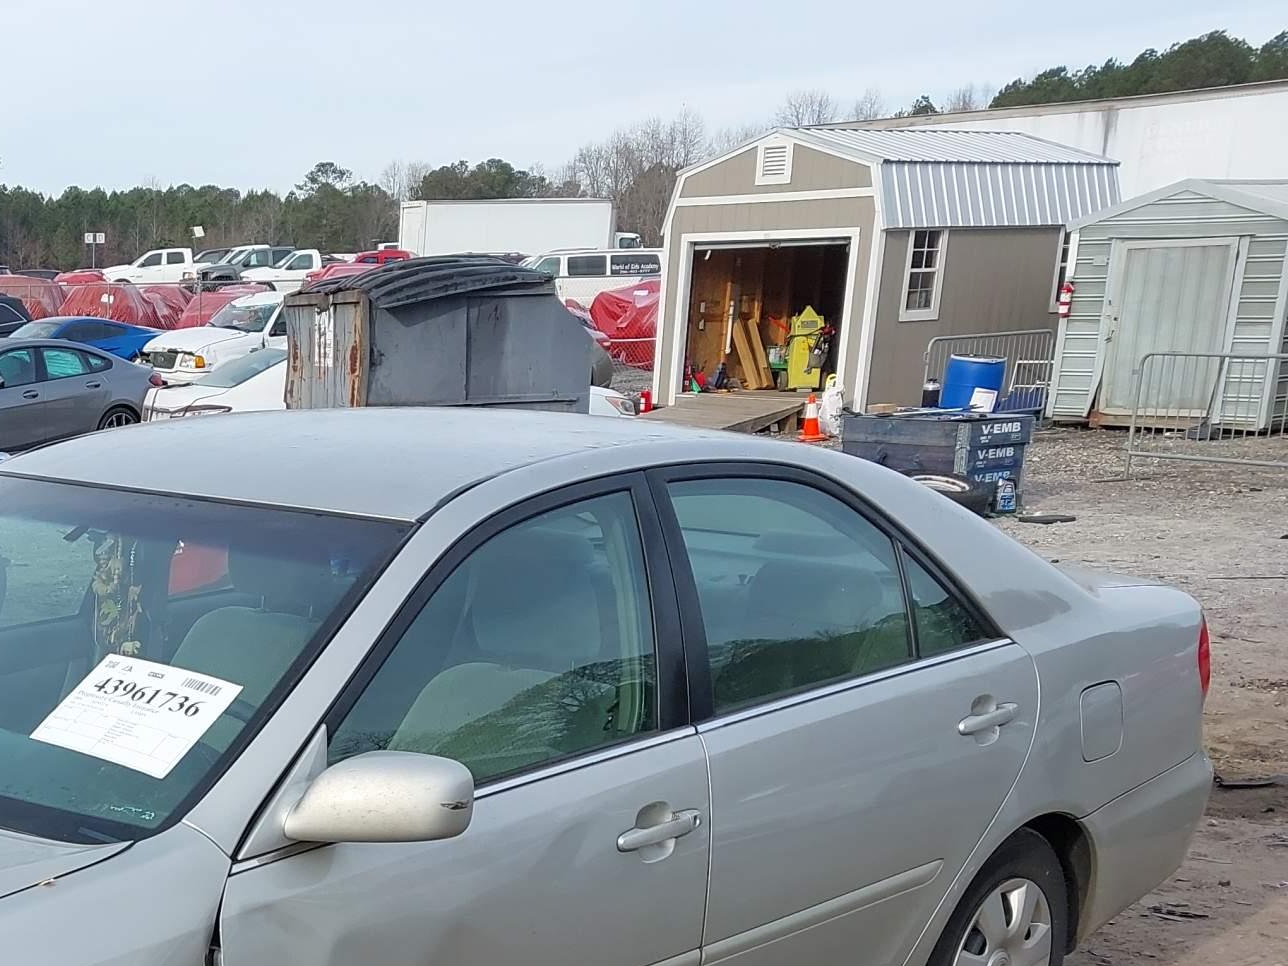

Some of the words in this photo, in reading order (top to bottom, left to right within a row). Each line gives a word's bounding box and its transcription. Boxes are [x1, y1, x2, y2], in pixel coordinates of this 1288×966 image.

[981, 422, 1022, 434] V-EMB
[977, 447, 1015, 460] V-EMB
[94, 677, 207, 717] 43961736
